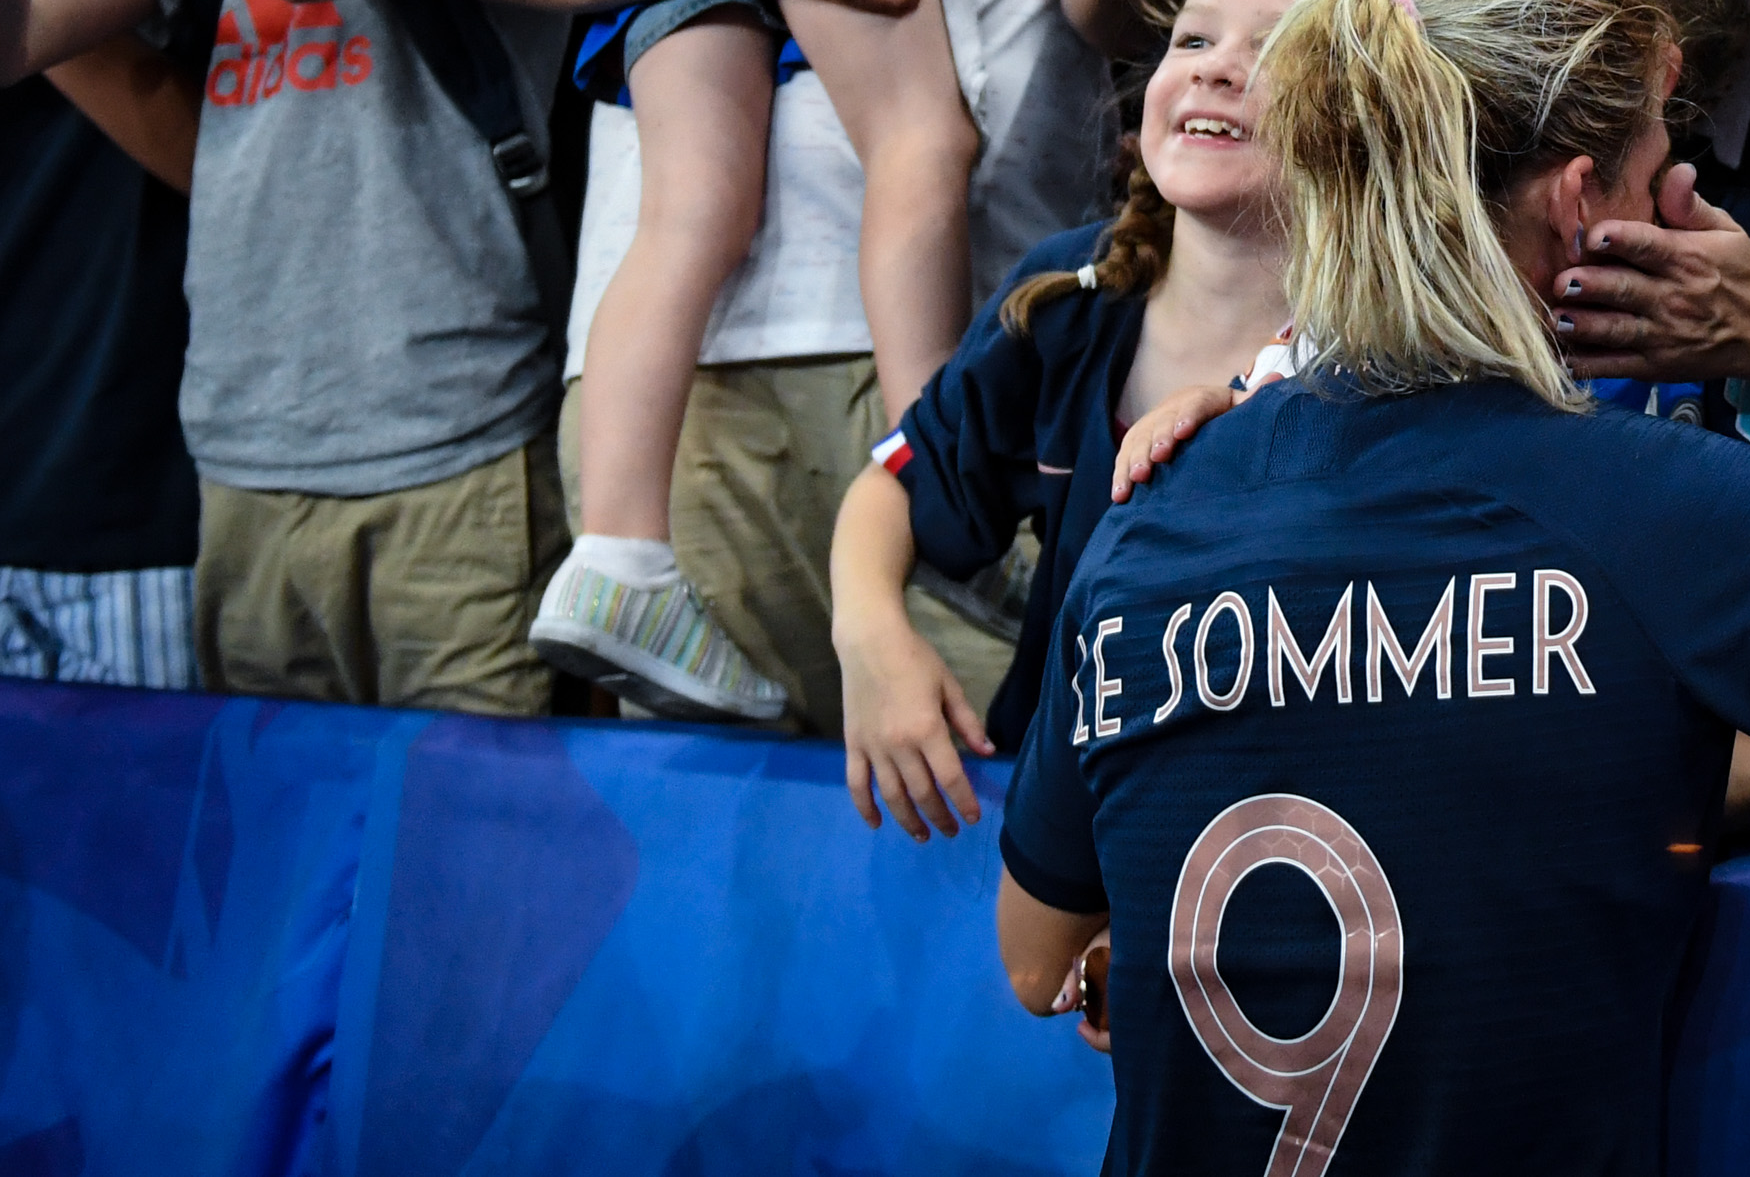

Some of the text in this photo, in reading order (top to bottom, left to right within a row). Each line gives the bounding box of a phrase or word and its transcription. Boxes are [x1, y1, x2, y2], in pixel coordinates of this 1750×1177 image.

[1073, 569, 1596, 746] LE SOMMER
[1168, 793, 1404, 1177] 9
